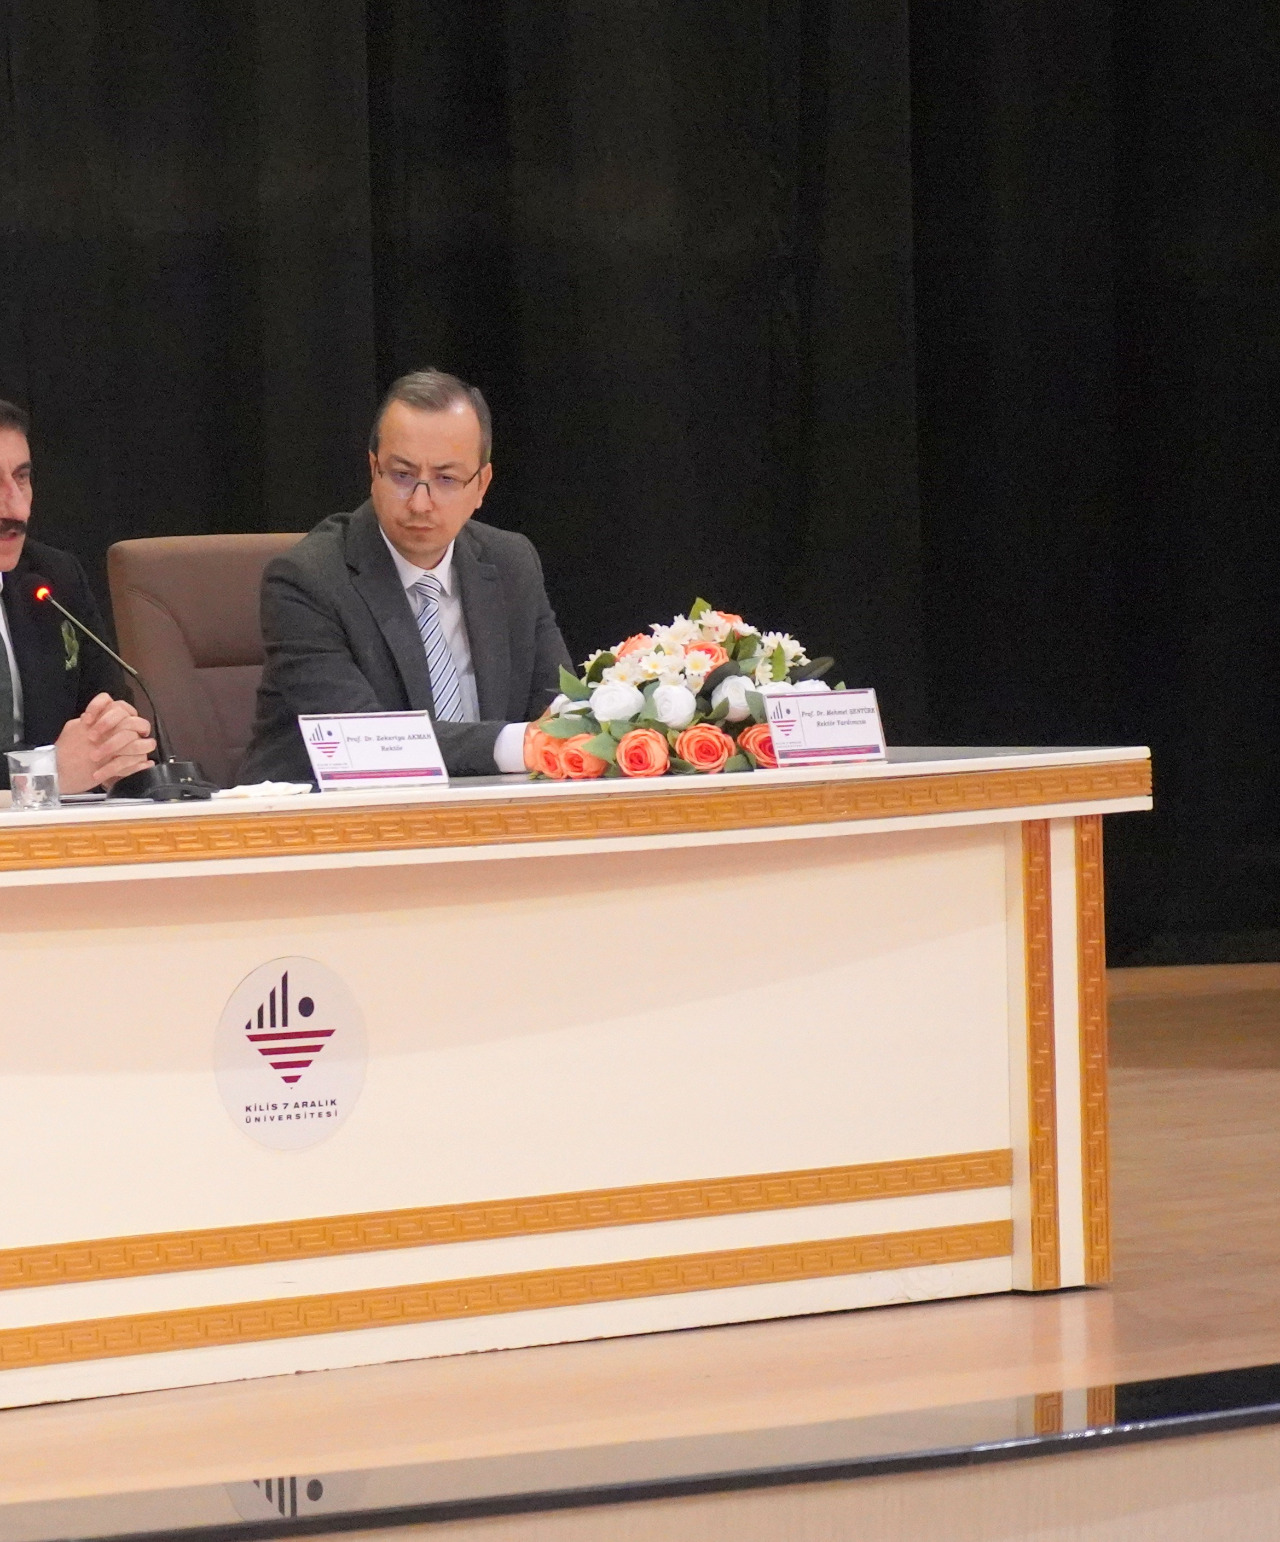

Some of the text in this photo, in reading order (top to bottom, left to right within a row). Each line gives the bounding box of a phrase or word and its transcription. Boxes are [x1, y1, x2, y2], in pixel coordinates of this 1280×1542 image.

[245, 1099, 337, 1112] KİLİS 7 ARALIK
[245, 1110, 338, 1123] ÜNİVERSİTESİ
